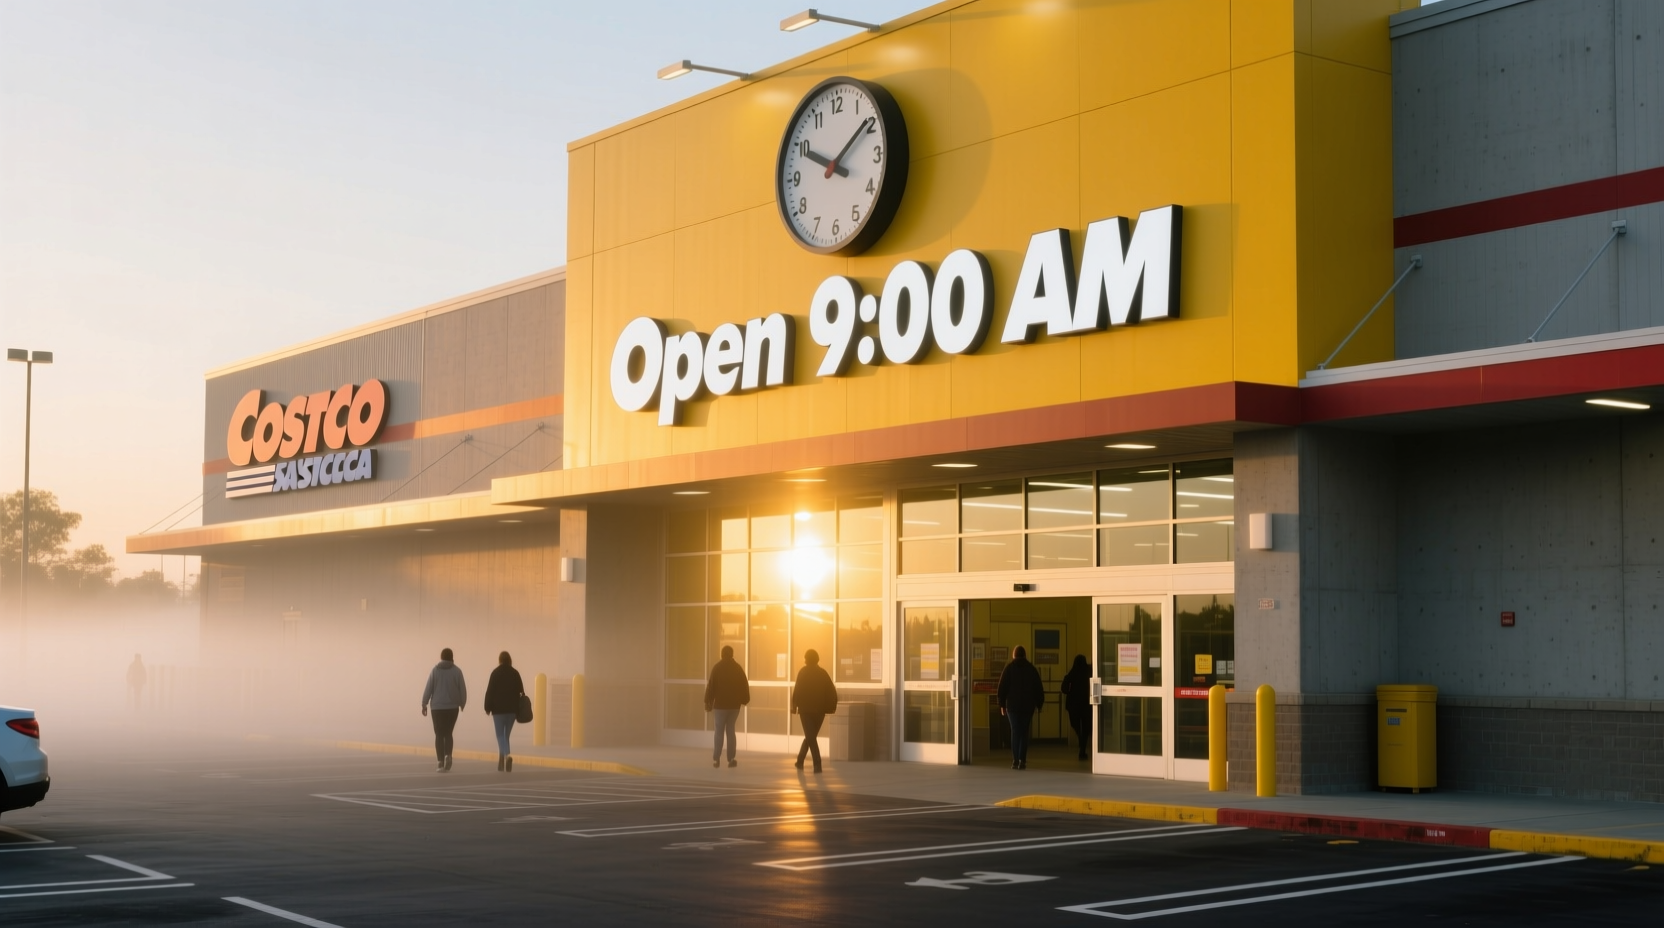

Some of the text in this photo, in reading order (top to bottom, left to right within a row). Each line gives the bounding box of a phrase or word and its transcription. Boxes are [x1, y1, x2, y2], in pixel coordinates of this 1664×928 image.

[830, 96, 843, 115] 12
[814, 111, 823, 130] 11
[866, 116, 876, 134] 2
[800, 139, 810, 158] 10
[873, 145, 883, 163] 3
[793, 170, 801, 187] 9
[865, 177, 876, 195] 4
[799, 197, 807, 214] 8
[852, 204, 860, 222] 5
[813, 216, 821, 233] 7
[832, 219, 840, 235] 6
[610, 204, 1182, 426] Open 9:00 AM
[227, 378, 386, 466] COSTCO
